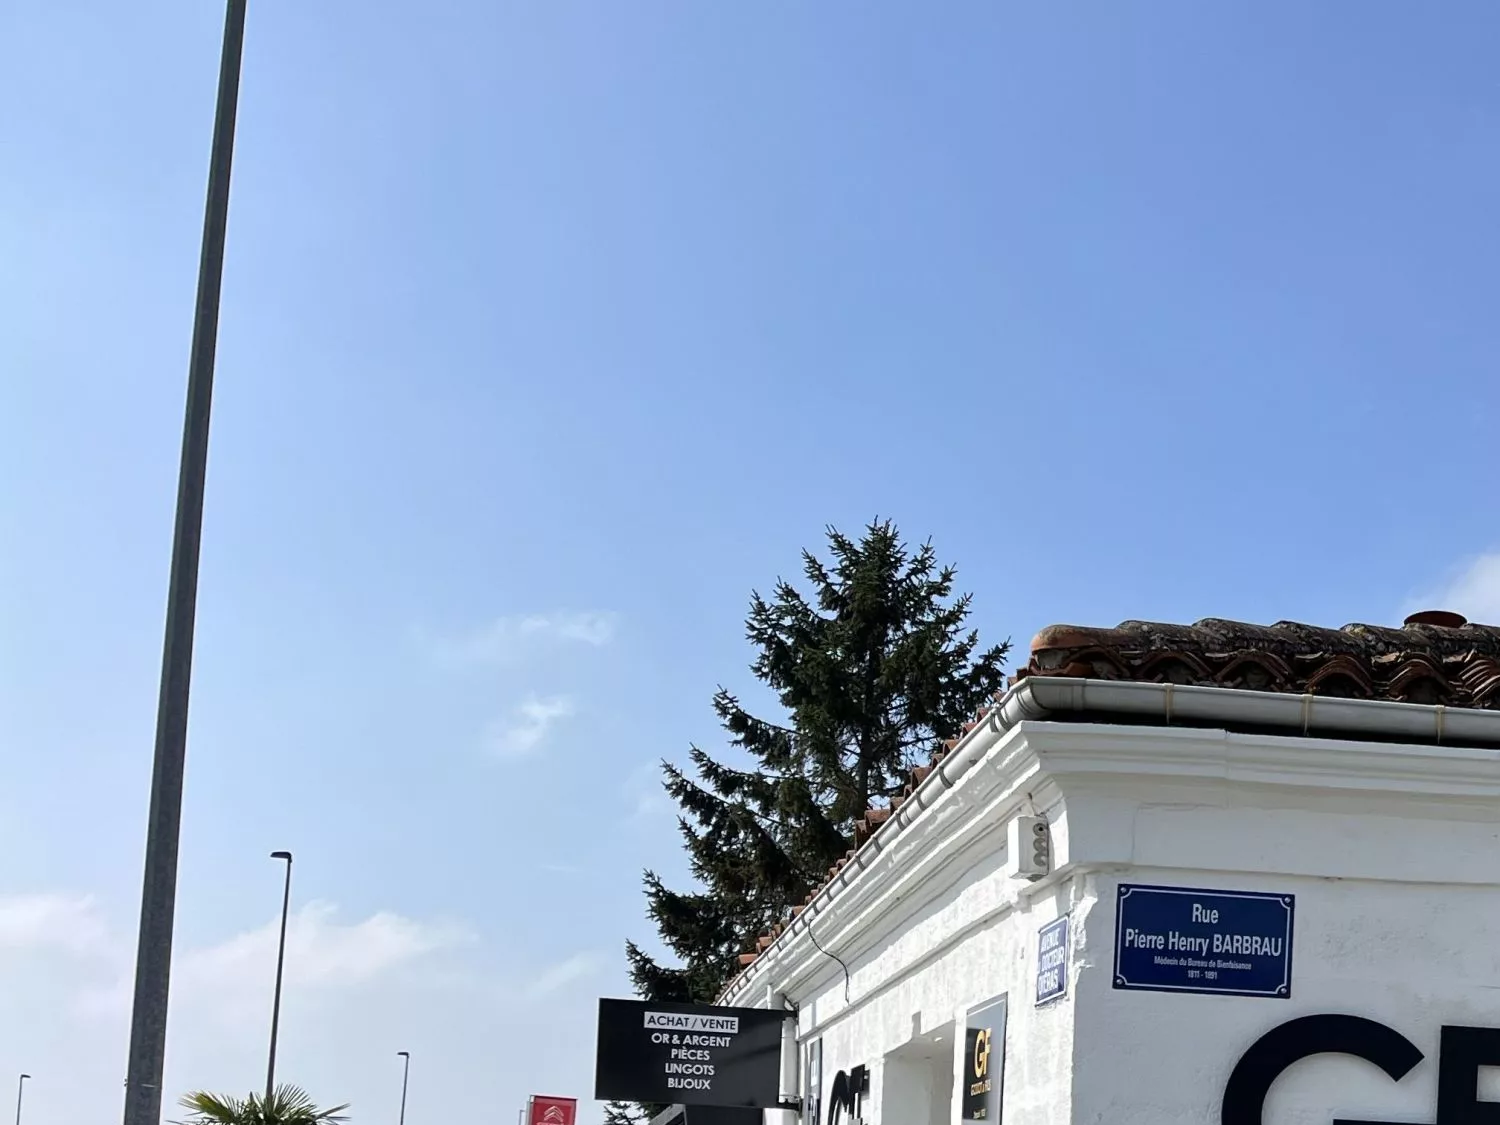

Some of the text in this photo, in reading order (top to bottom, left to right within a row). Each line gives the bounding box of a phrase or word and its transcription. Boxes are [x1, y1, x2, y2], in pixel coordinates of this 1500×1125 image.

[1192, 903, 1219, 924] Rue
[1125, 928, 1282, 957] Pierre Henry BARBRAU
[1179, 957, 1187, 967] du
[1188, 957, 1208, 968] Bureau
[1208, 958, 1216, 968] de
[1216, 959, 1251, 970] Bienfaisance
[648, 1015, 736, 1030] ACHAT / VENTE
[651, 1032, 731, 1047] OR & ARGENT
[671, 1046, 710, 1060] PIÈCES
[665, 1063, 715, 1075] LINGOTS
[667, 1077, 711, 1090] BIJOUX
